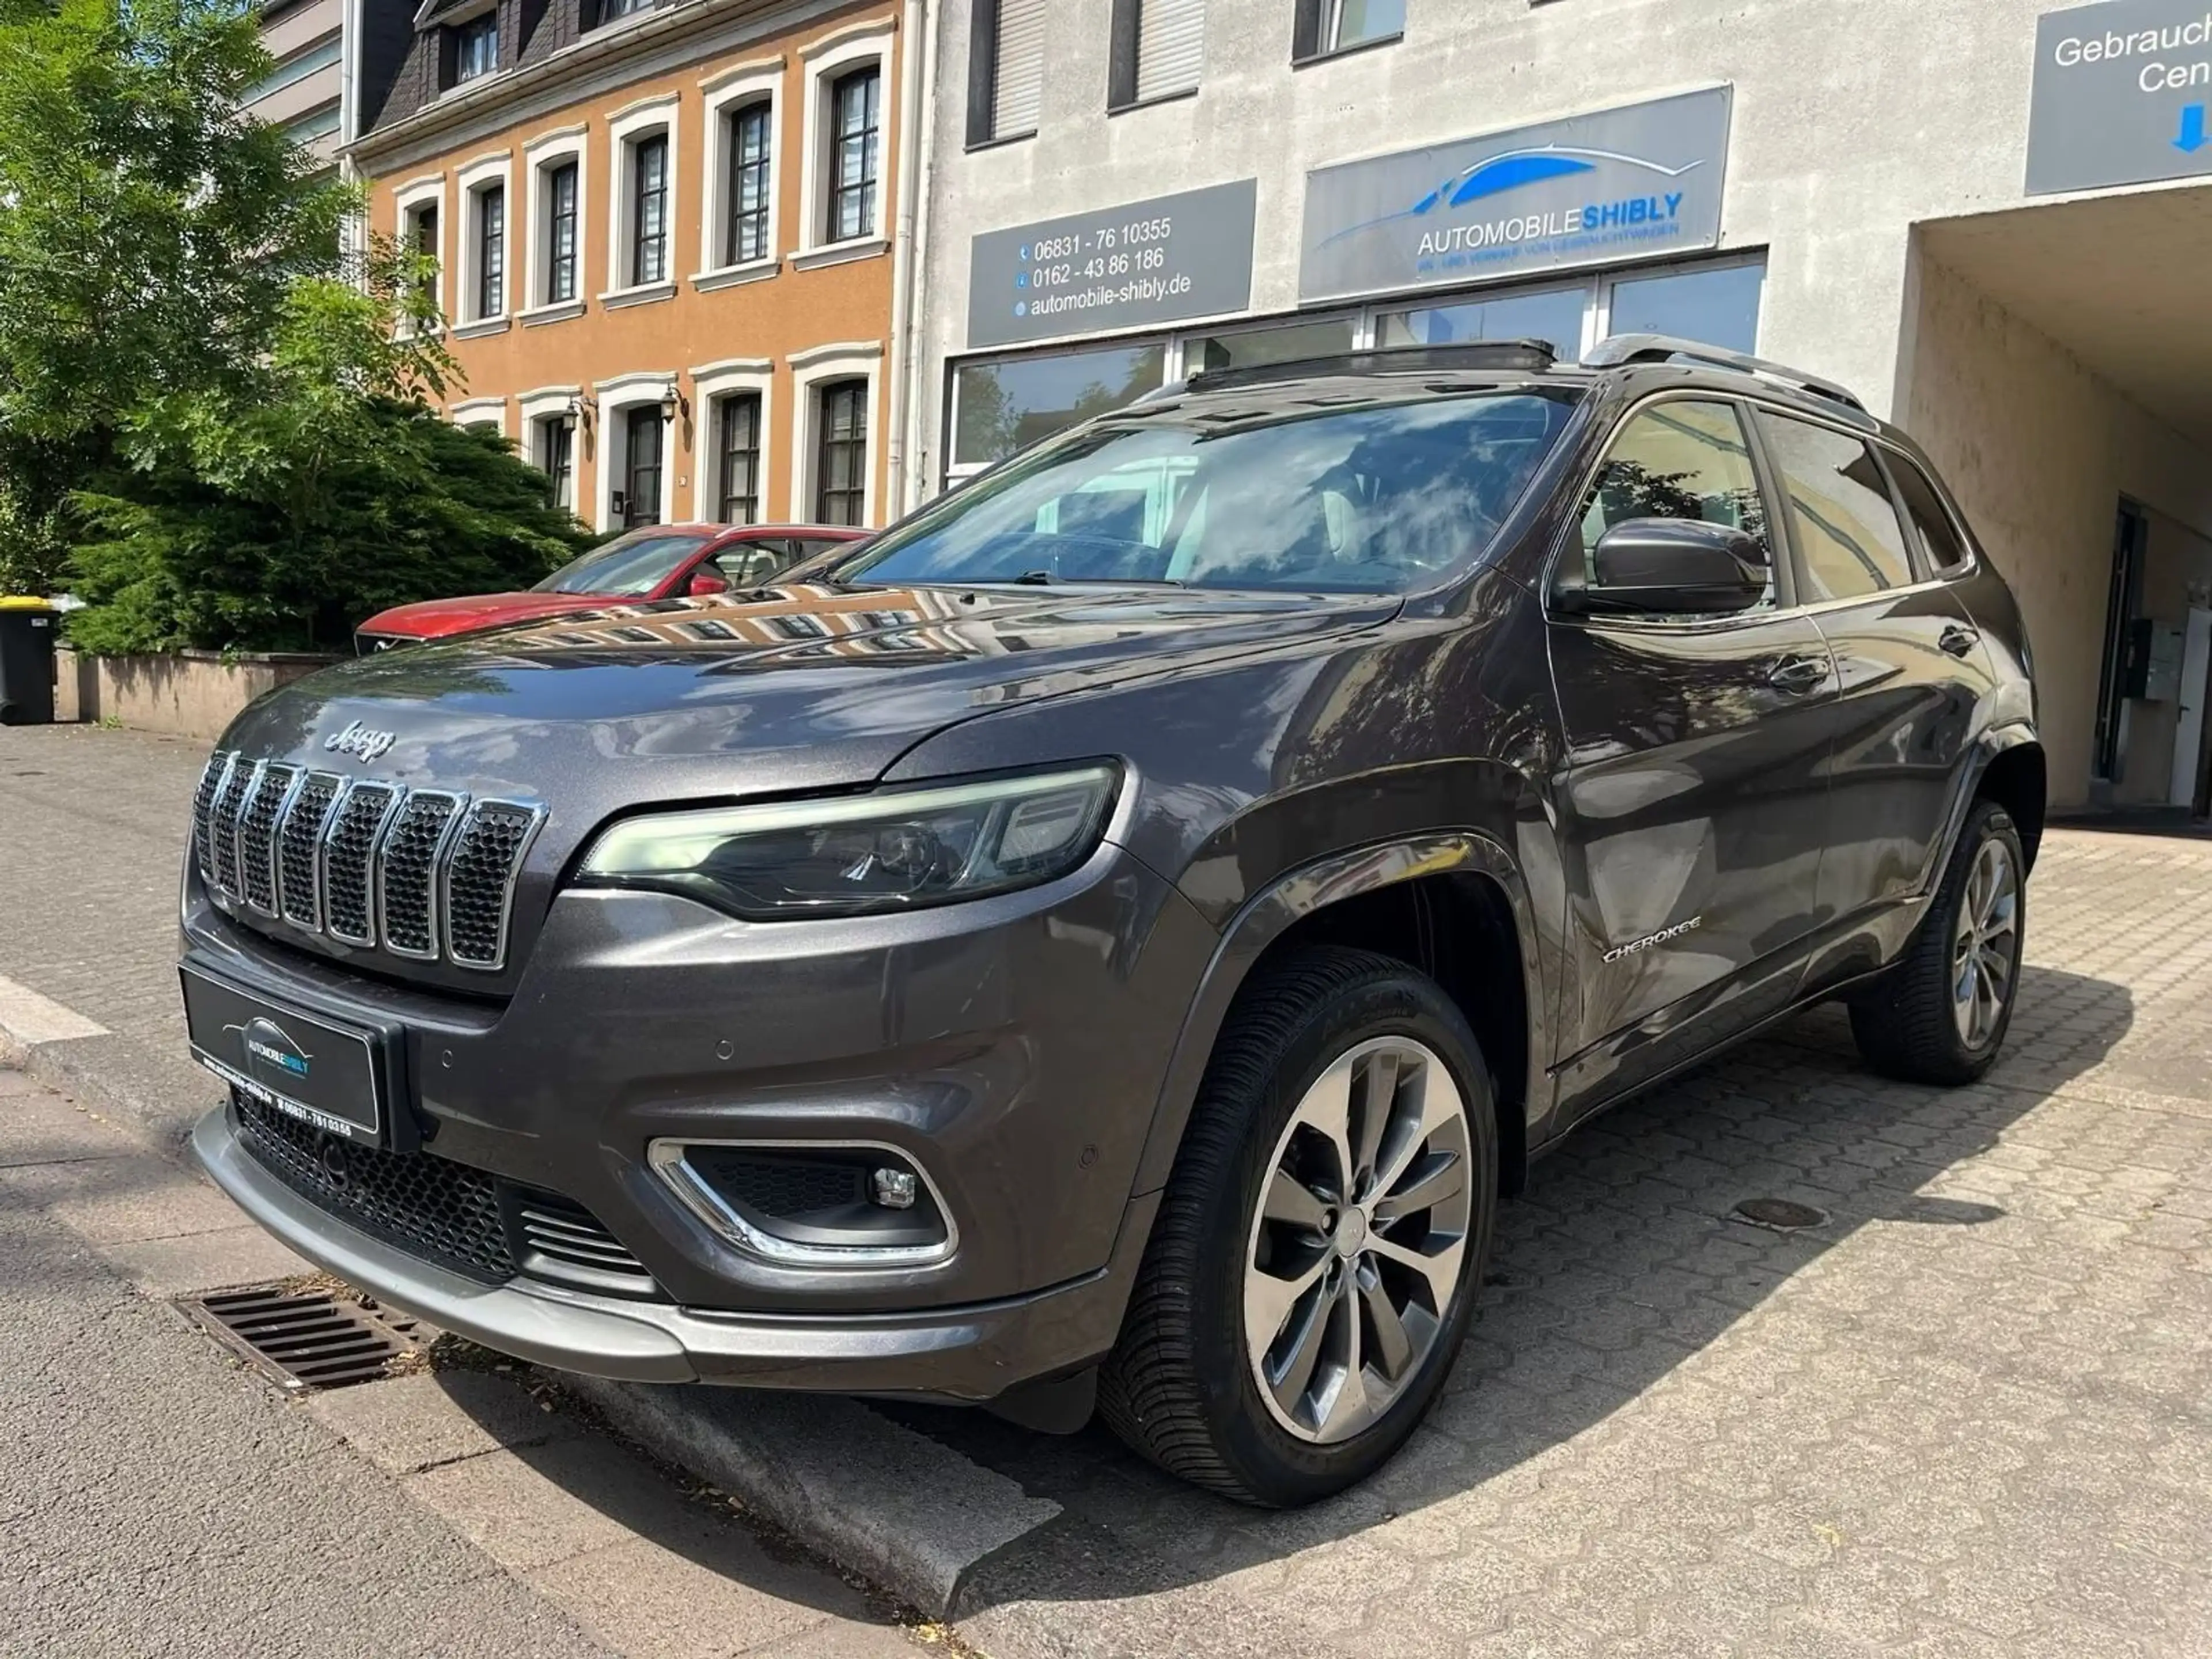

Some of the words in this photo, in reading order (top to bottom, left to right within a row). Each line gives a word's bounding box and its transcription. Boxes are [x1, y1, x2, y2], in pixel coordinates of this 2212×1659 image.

[1034, 234, 1080, 261] 06831
[1096, 228, 1116, 251] 76
[1122, 217, 1171, 245] 10355
[1032, 265, 1070, 289] 0162
[1084, 258, 1105, 279] 43
[1109, 253, 1129, 275] 86
[1135, 247, 1164, 271] 186
[1031, 272, 1191, 315] automobile-shibly.de
[324, 719, 396, 764] Jeep
[1602, 916, 1701, 963] CHEROKEE
